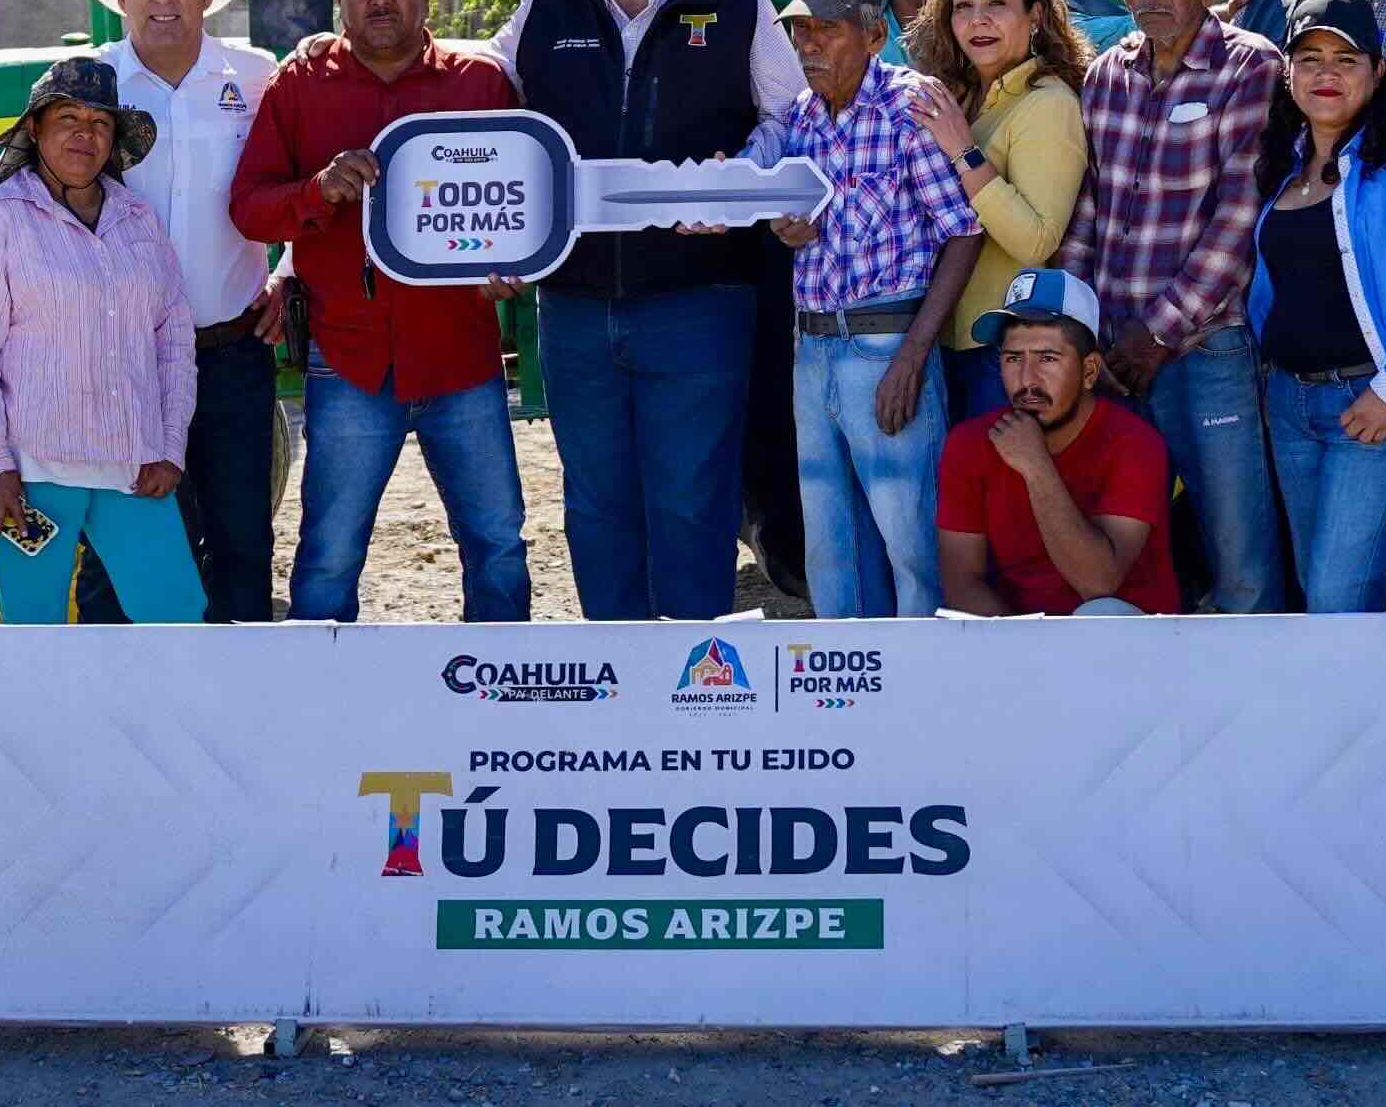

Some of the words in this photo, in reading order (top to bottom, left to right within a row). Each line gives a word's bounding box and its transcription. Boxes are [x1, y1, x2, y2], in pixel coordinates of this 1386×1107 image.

[679, 12, 717, 46] T
[431, 145, 498, 161] COAHUILA
[414, 180, 525, 207] TODOS
[417, 213, 465, 232] POR
[471, 206, 525, 232] MÁS
[788, 643, 882, 672] TODOS
[441, 654, 619, 694] COAHUILA
[790, 677, 831, 693] POR
[836, 672, 882, 693] MÁS
[531, 689, 588, 700] DELANTE
[671, 693, 713, 703] RAMOS
[716, 693, 758, 703] ARIZPE
[470, 749, 651, 772] PROGRAMA
[661, 749, 702, 771] EN
[711, 749, 750, 771] TU
[762, 748, 855, 770] EJIDO
[358, 772, 510, 878] TÚ
[532, 805, 972, 877] DECIDES
[474, 908, 649, 940] RAMOS
[665, 907, 846, 939] ARIZPE
